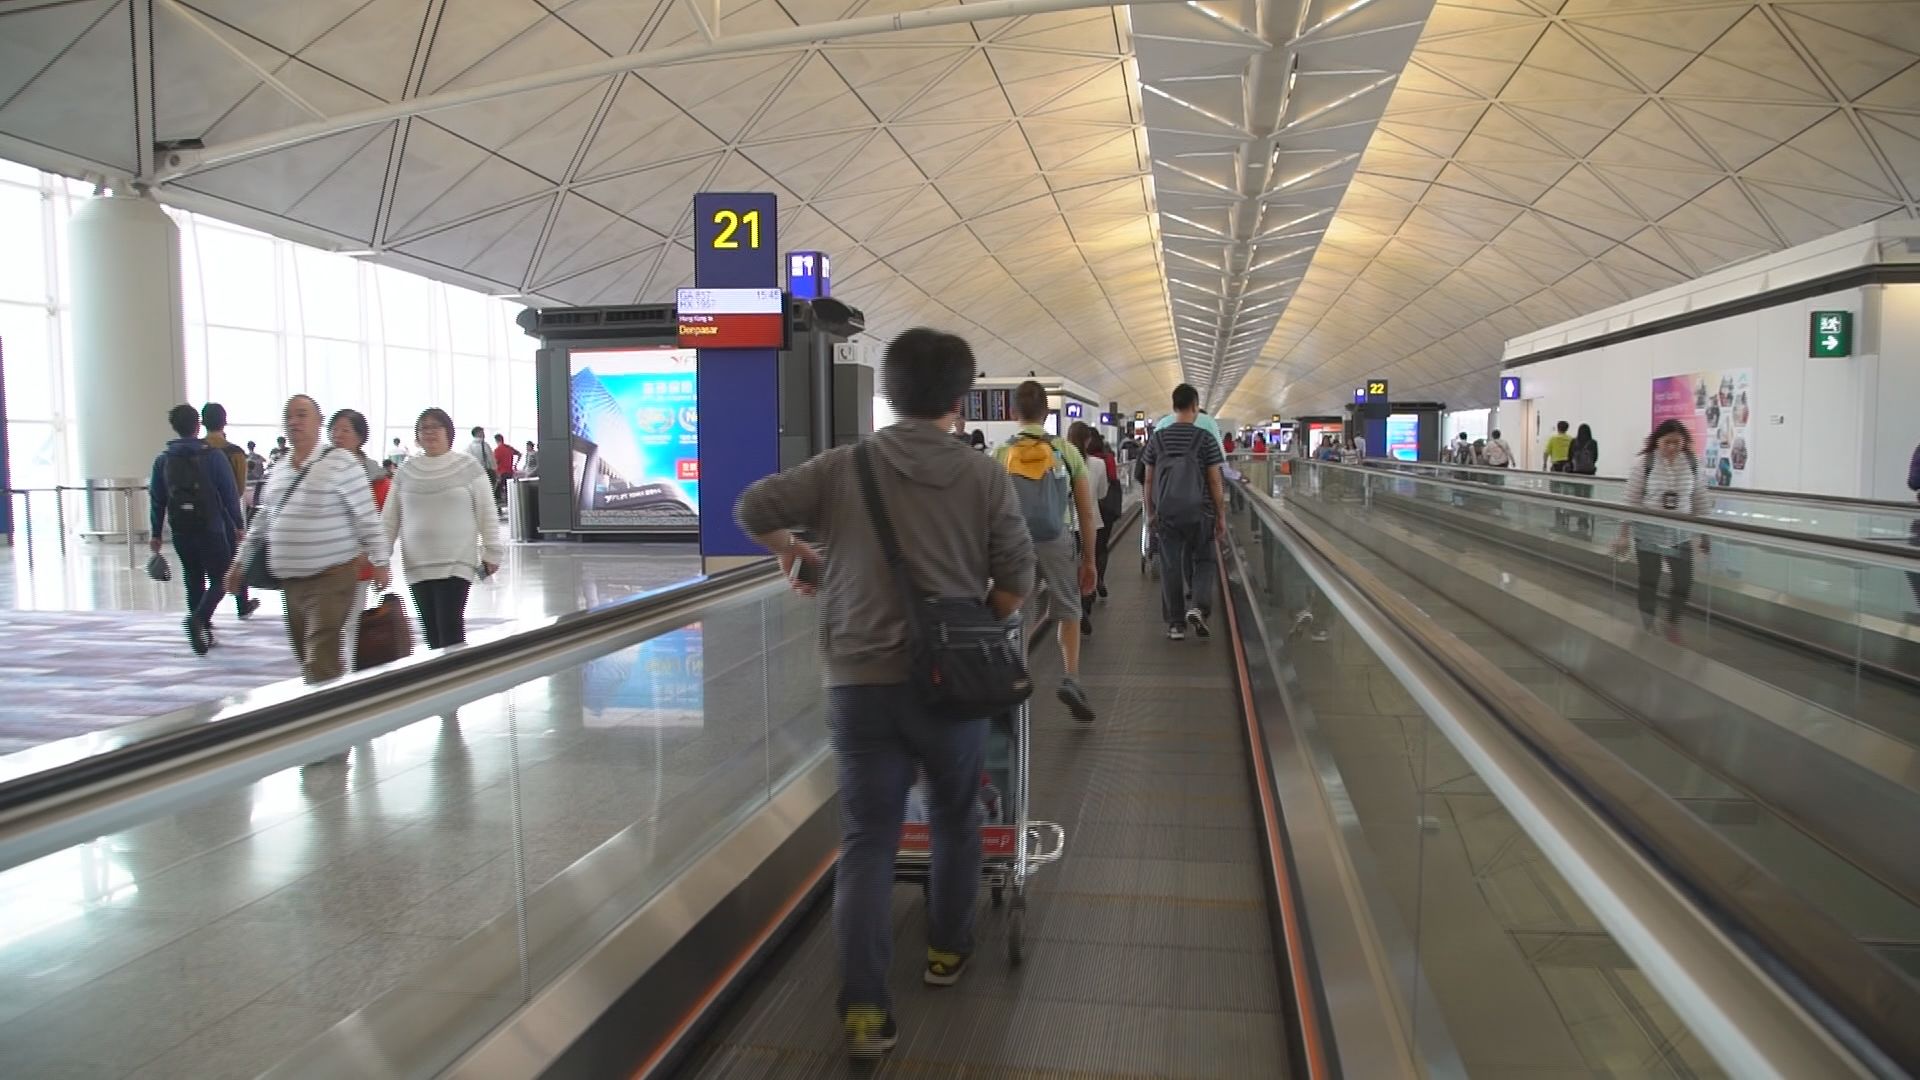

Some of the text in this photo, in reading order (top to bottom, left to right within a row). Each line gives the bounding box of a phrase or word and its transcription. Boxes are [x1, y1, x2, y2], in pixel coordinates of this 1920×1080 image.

[713, 210, 760, 249] 21
[678, 325, 719, 337] Denpasar
[1369, 383, 1385, 395] 22
